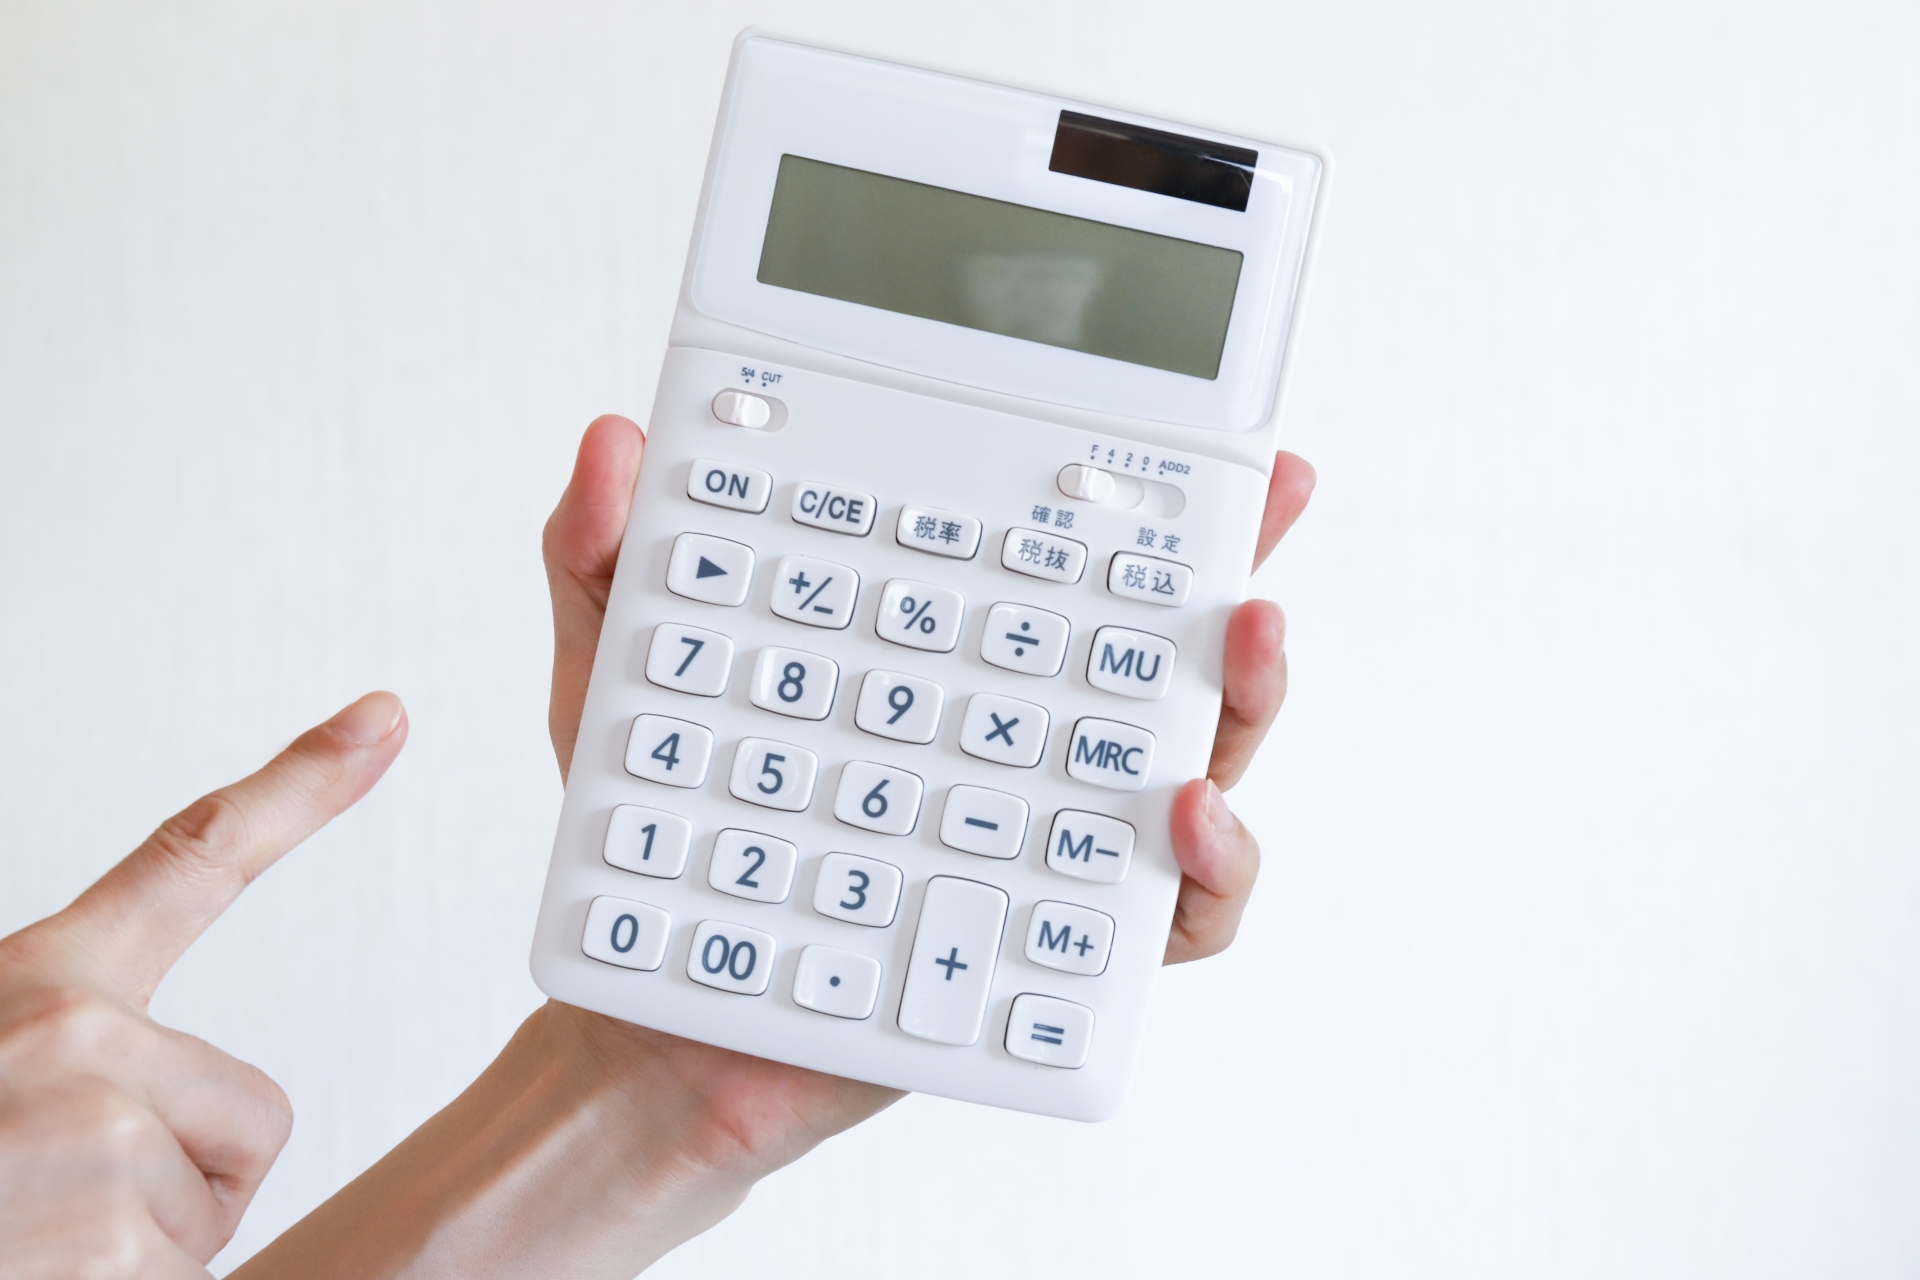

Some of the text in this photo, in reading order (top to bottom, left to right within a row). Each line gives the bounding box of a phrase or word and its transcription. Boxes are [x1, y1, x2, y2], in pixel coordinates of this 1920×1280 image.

[741, 367, 783, 383] 5/4 CUT
[1092, 444, 1191, 475] F 4 2 0 ADD2
[706, 470, 749, 499] ON
[800, 490, 864, 524] C/CE
[1031, 505, 1075, 530] 確認
[914, 517, 961, 544] 税率
[1136, 527, 1181, 554] 設定
[1018, 538, 1070, 572] 税抜
[1123, 564, 1175, 596] 税込
[675, 637, 704, 676] 7
[1100, 644, 1161, 681] MU
[778, 662, 806, 702] 8
[887, 686, 914, 725] 9
[651, 733, 680, 770] 4
[1075, 735, 1144, 775] MRC
[757, 753, 785, 794] 5
[862, 779, 890, 818] 6
[641, 824, 656, 860] 1
[736, 846, 765, 888] 2
[840, 870, 869, 910] 3
[611, 914, 638, 953] 0
[1038, 921, 1094, 956] M+
[702, 935, 757, 981] 00
